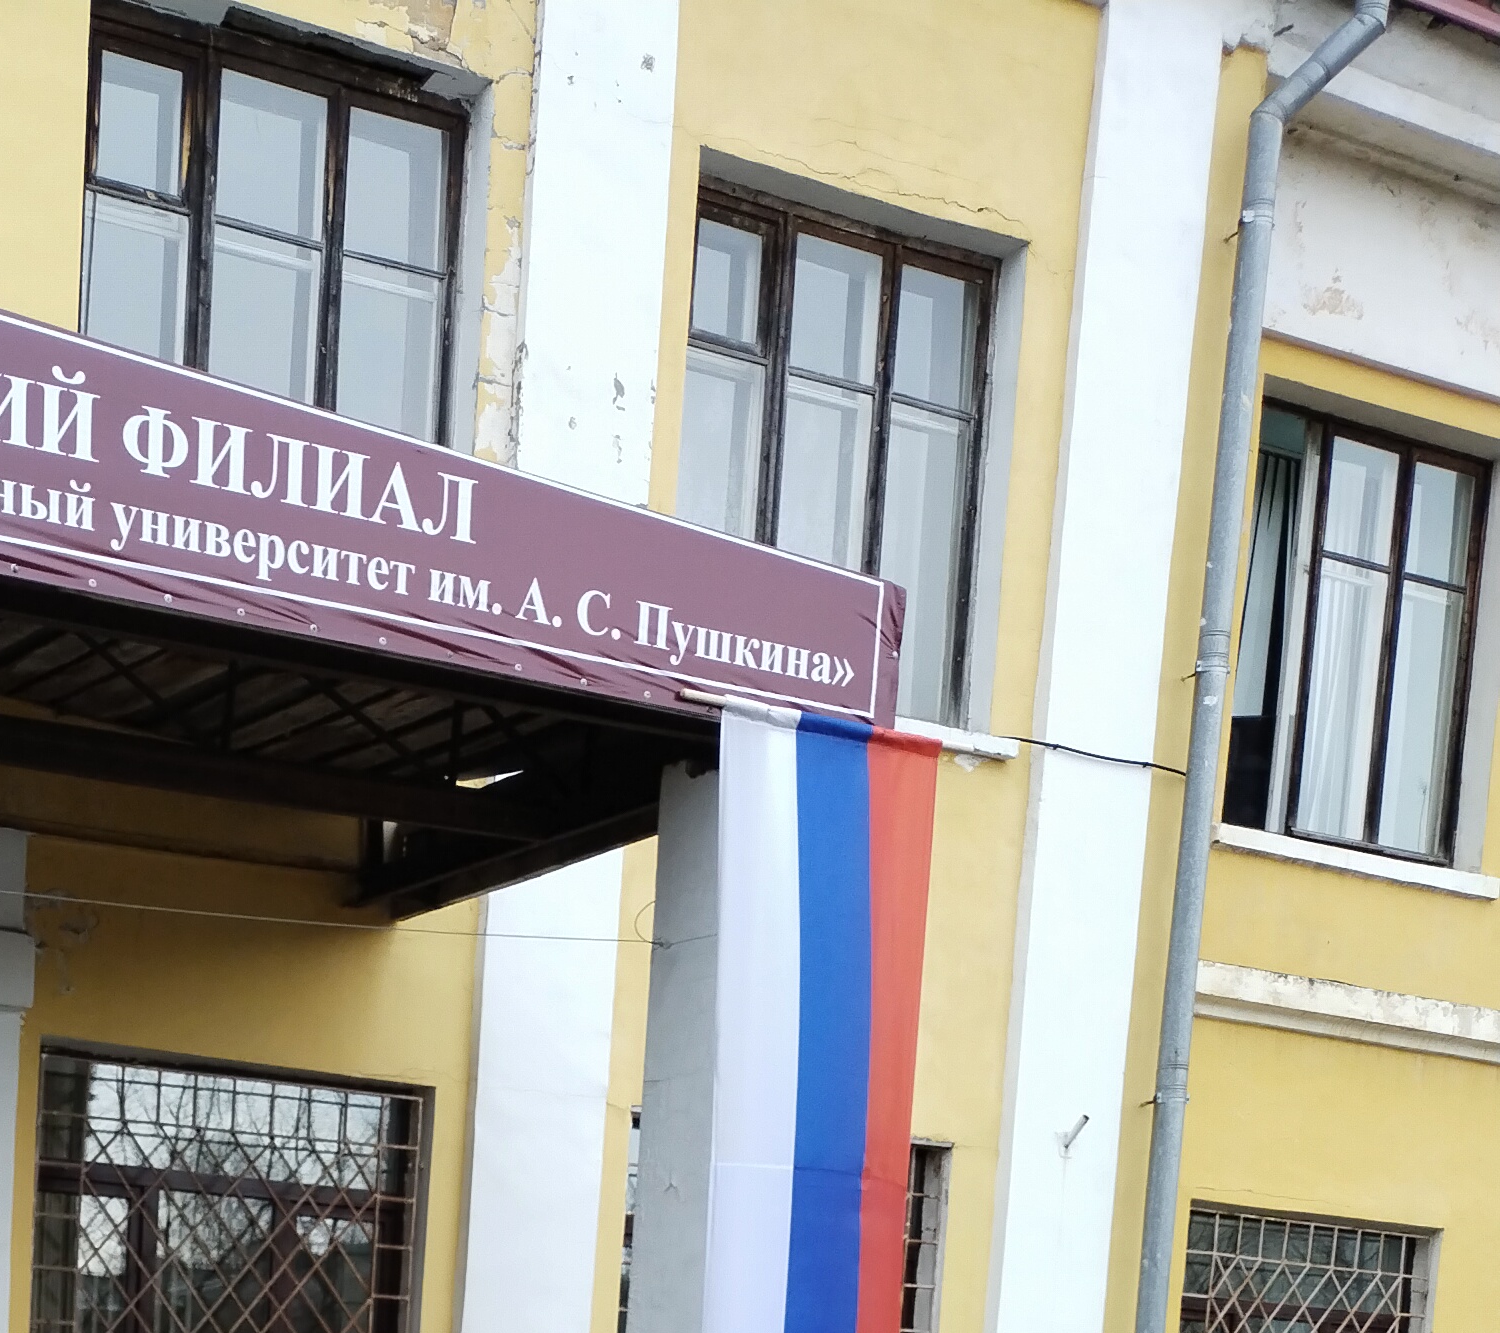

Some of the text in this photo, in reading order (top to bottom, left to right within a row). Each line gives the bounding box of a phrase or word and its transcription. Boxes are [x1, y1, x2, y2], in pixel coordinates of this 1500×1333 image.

[123, 405, 479, 544] ФИЛИАЛ
[110, 502, 416, 595] университет
[427, 569, 502, 615] им.
[515, 577, 562, 627] А.
[577, 590, 621, 640] С.
[633, 600, 854, 688] Пушкина»
